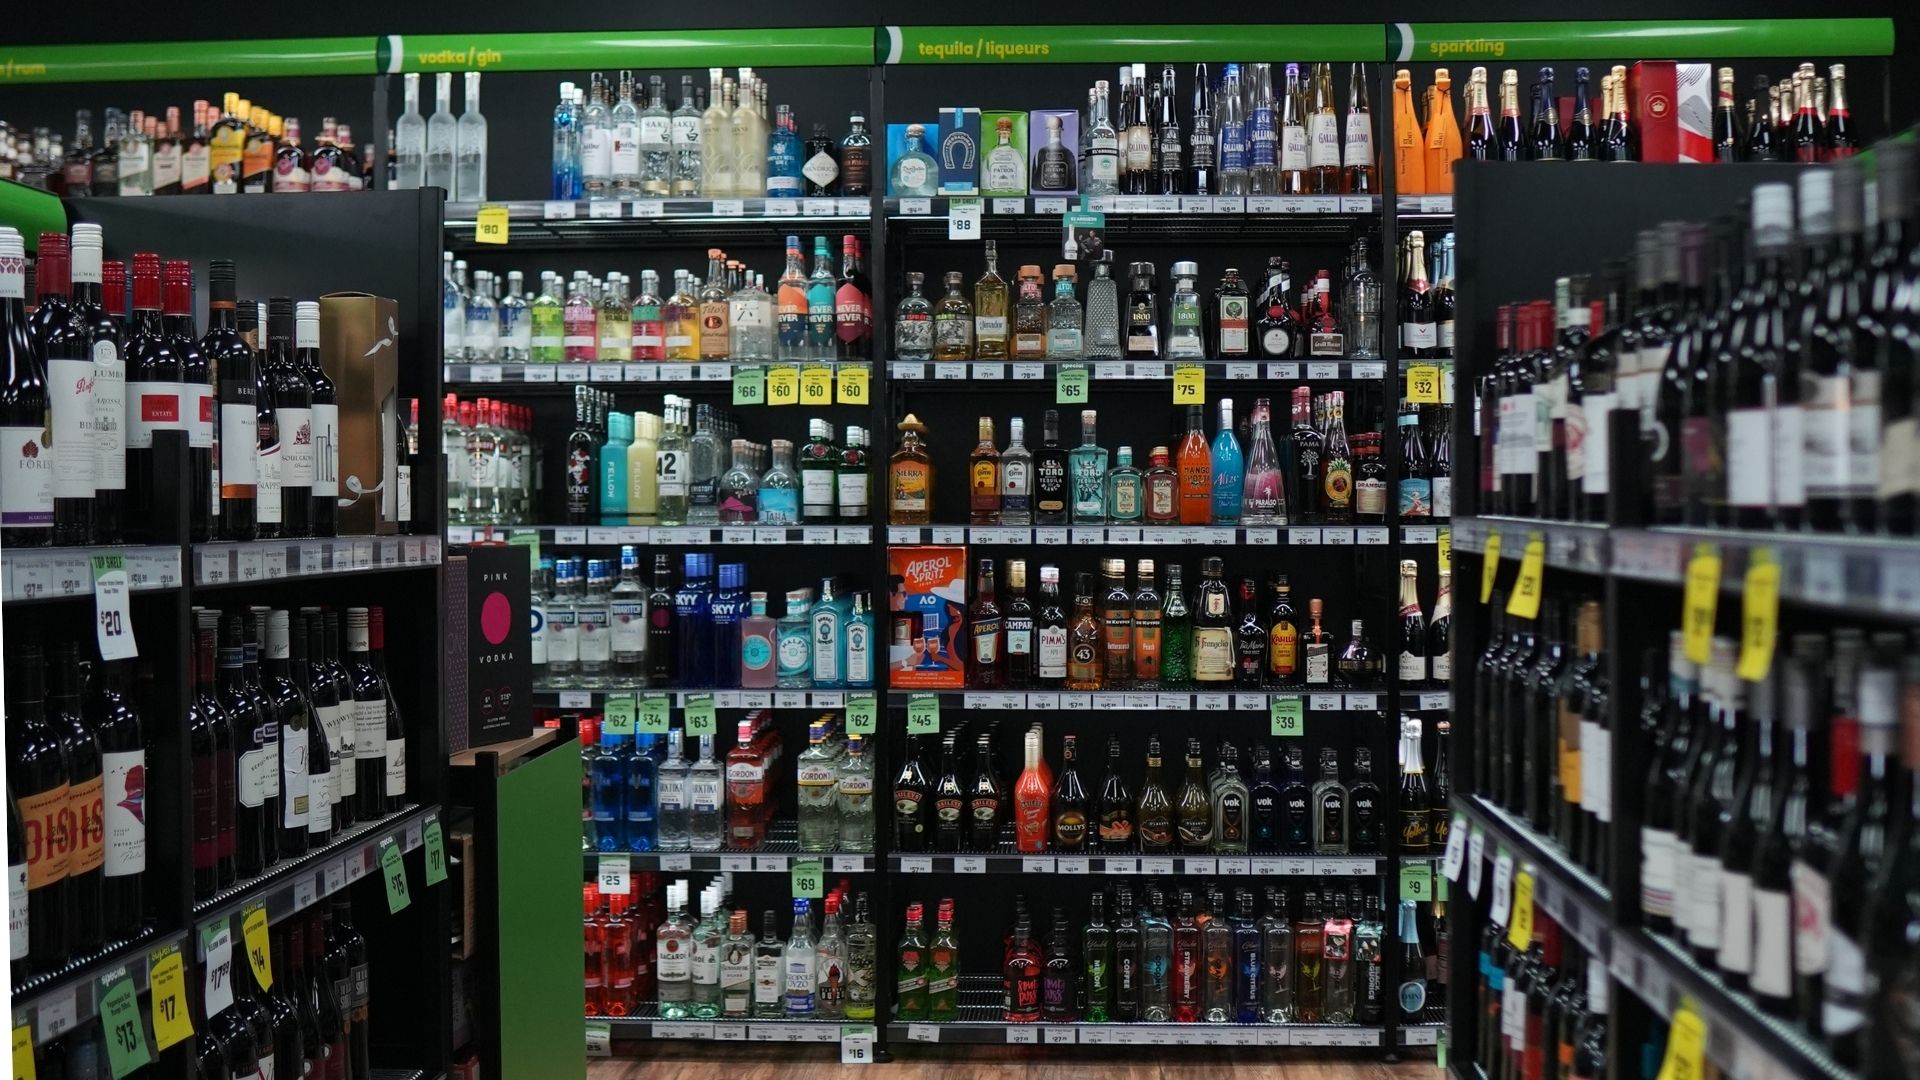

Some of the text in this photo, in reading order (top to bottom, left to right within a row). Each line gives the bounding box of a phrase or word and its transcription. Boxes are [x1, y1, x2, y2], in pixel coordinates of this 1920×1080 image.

[1430, 38, 1505, 56] sparkling
[418, 50, 467, 65] vodka
[477, 49, 501, 67] gin
[480, 224, 499, 235] $80
[953, 219, 971, 230] $88
[702, 305, 727, 314] Tito's
[836, 304, 862, 313] NEVER
[809, 314, 833, 323] NEVER
[836, 313, 862, 322] NEVER
[1133, 313, 1151, 321] 1800
[1178, 312, 1196, 320] 1800
[737, 385, 757, 398] $66
[772, 384, 791, 397] $60
[805, 384, 824, 397] $60
[842, 384, 861, 397] $60
[1061, 384, 1080, 397] $65
[1177, 384, 1196, 396] $75
[1414, 380, 1432, 395] $32
[896, 470, 924, 478] SIERRA
[1038, 468, 1064, 476] TORO
[1184, 466, 1210, 474] MANGO
[607, 460, 615, 499] FELLOW
[632, 460, 641, 499] FELLOW
[568, 485, 590, 494] LOVE
[93, 555, 122, 568] TOP SHELF
[906, 557, 952, 577] APEROL
[483, 572, 508, 582] PINK
[913, 570, 945, 586] SPRITZ
[711, 604, 735, 615] SKYY
[101, 610, 123, 637] $20
[973, 622, 1000, 635] APEROL
[1041, 633, 1067, 645] PIMM'S
[480, 652, 515, 664] VODKA
[1076, 649, 1091, 659] 43
[608, 714, 627, 727] $62
[643, 713, 662, 726] $34
[689, 715, 708, 728] $63
[851, 714, 869, 727] $62
[912, 714, 932, 727] $45
[1275, 716, 1295, 729] $39
[935, 798, 963, 810] BAILEYS
[972, 798, 998, 810] BAILEYS
[1224, 798, 1240, 808] vok
[1256, 797, 1273, 807] vok
[1289, 799, 1305, 809] vok
[1325, 799, 1341, 809] vok
[1356, 798, 1373, 809] vok
[1403, 821, 1429, 842] Yellow
[430, 848, 440, 871] $17
[391, 872, 405, 897] $15
[601, 874, 620, 886] $25
[797, 877, 815, 891] $69
[1409, 879, 1421, 894] $9
[251, 946, 267, 974] $14
[100, 968, 127, 987] special
[1093, 959, 1101, 988] MELON
[1183, 951, 1191, 999] STRAWBERRY
[159, 994, 176, 1023] $17
[115, 1020, 137, 1054] $13
[849, 1048, 864, 1059] $16
